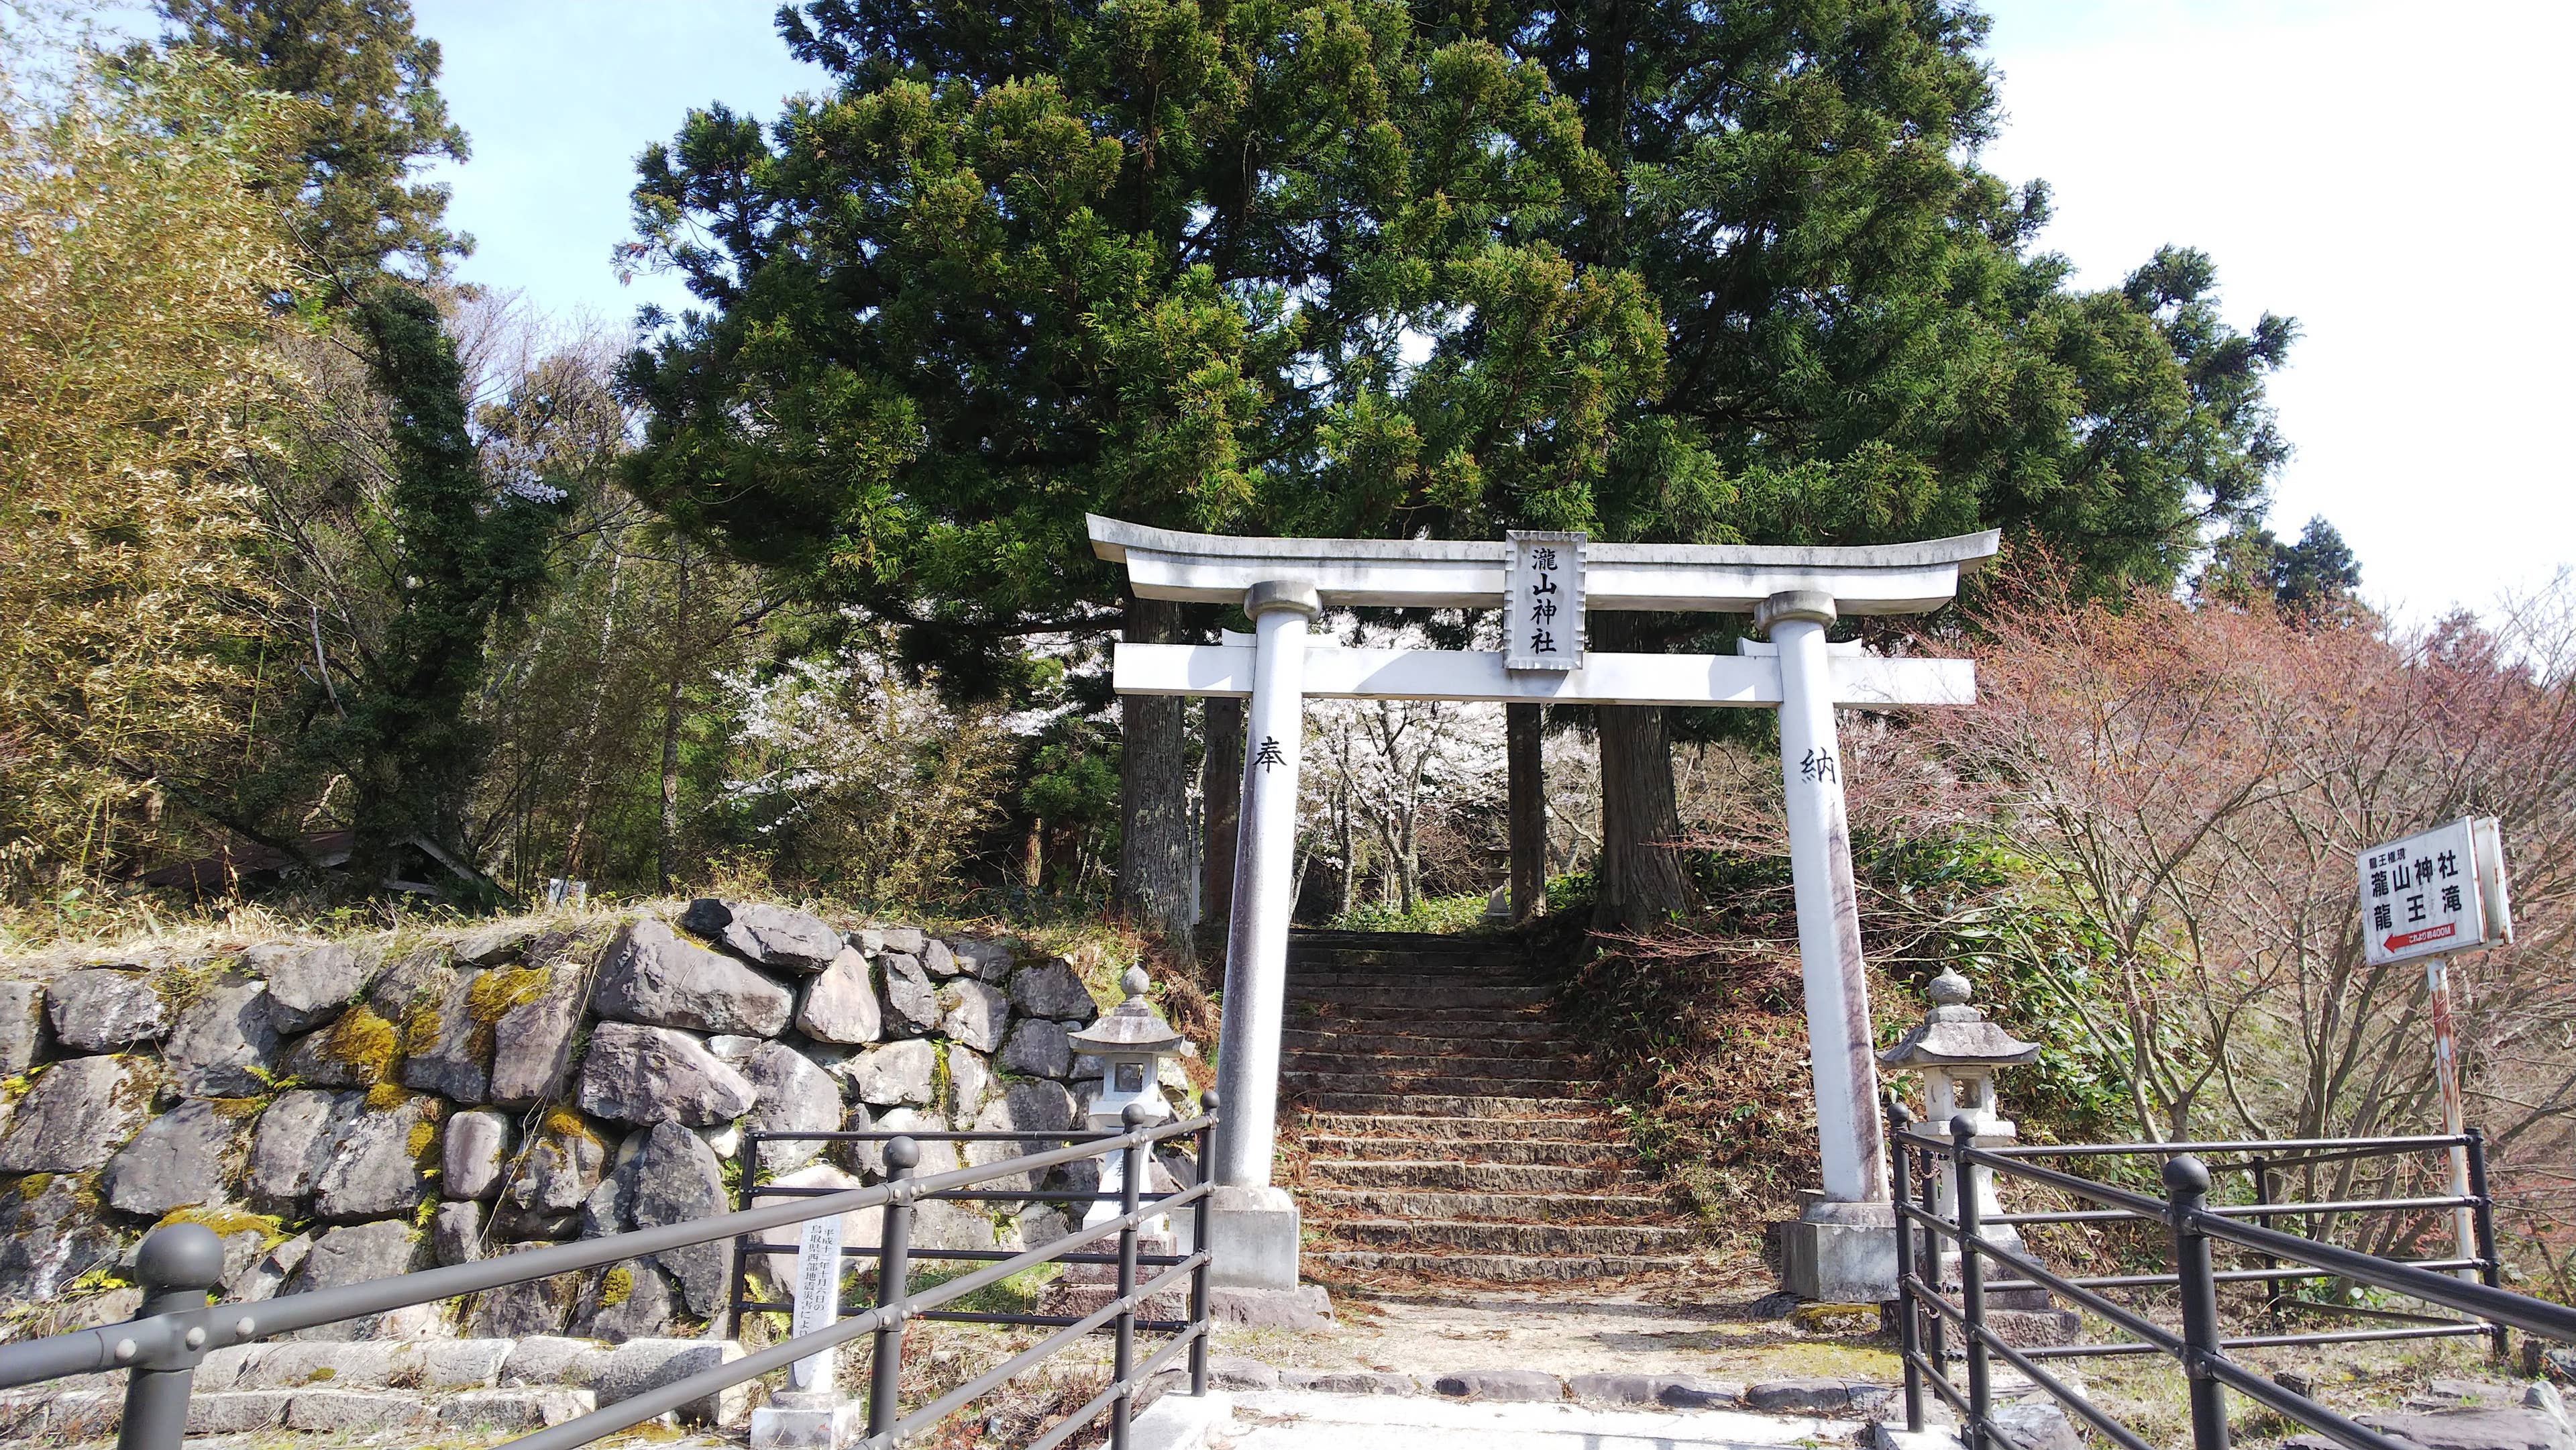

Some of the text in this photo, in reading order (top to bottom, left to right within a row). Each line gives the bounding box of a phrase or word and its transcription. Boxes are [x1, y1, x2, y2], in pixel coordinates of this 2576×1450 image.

[1530, 548, 1558, 655] 瀧山神社
[1252, 735, 1287, 774] 奉
[1800, 746, 1836, 784] 納
[2373, 884, 2462, 931] 龍王滝
[814, 1229, 835, 1311] 平成十二年十月六日の
